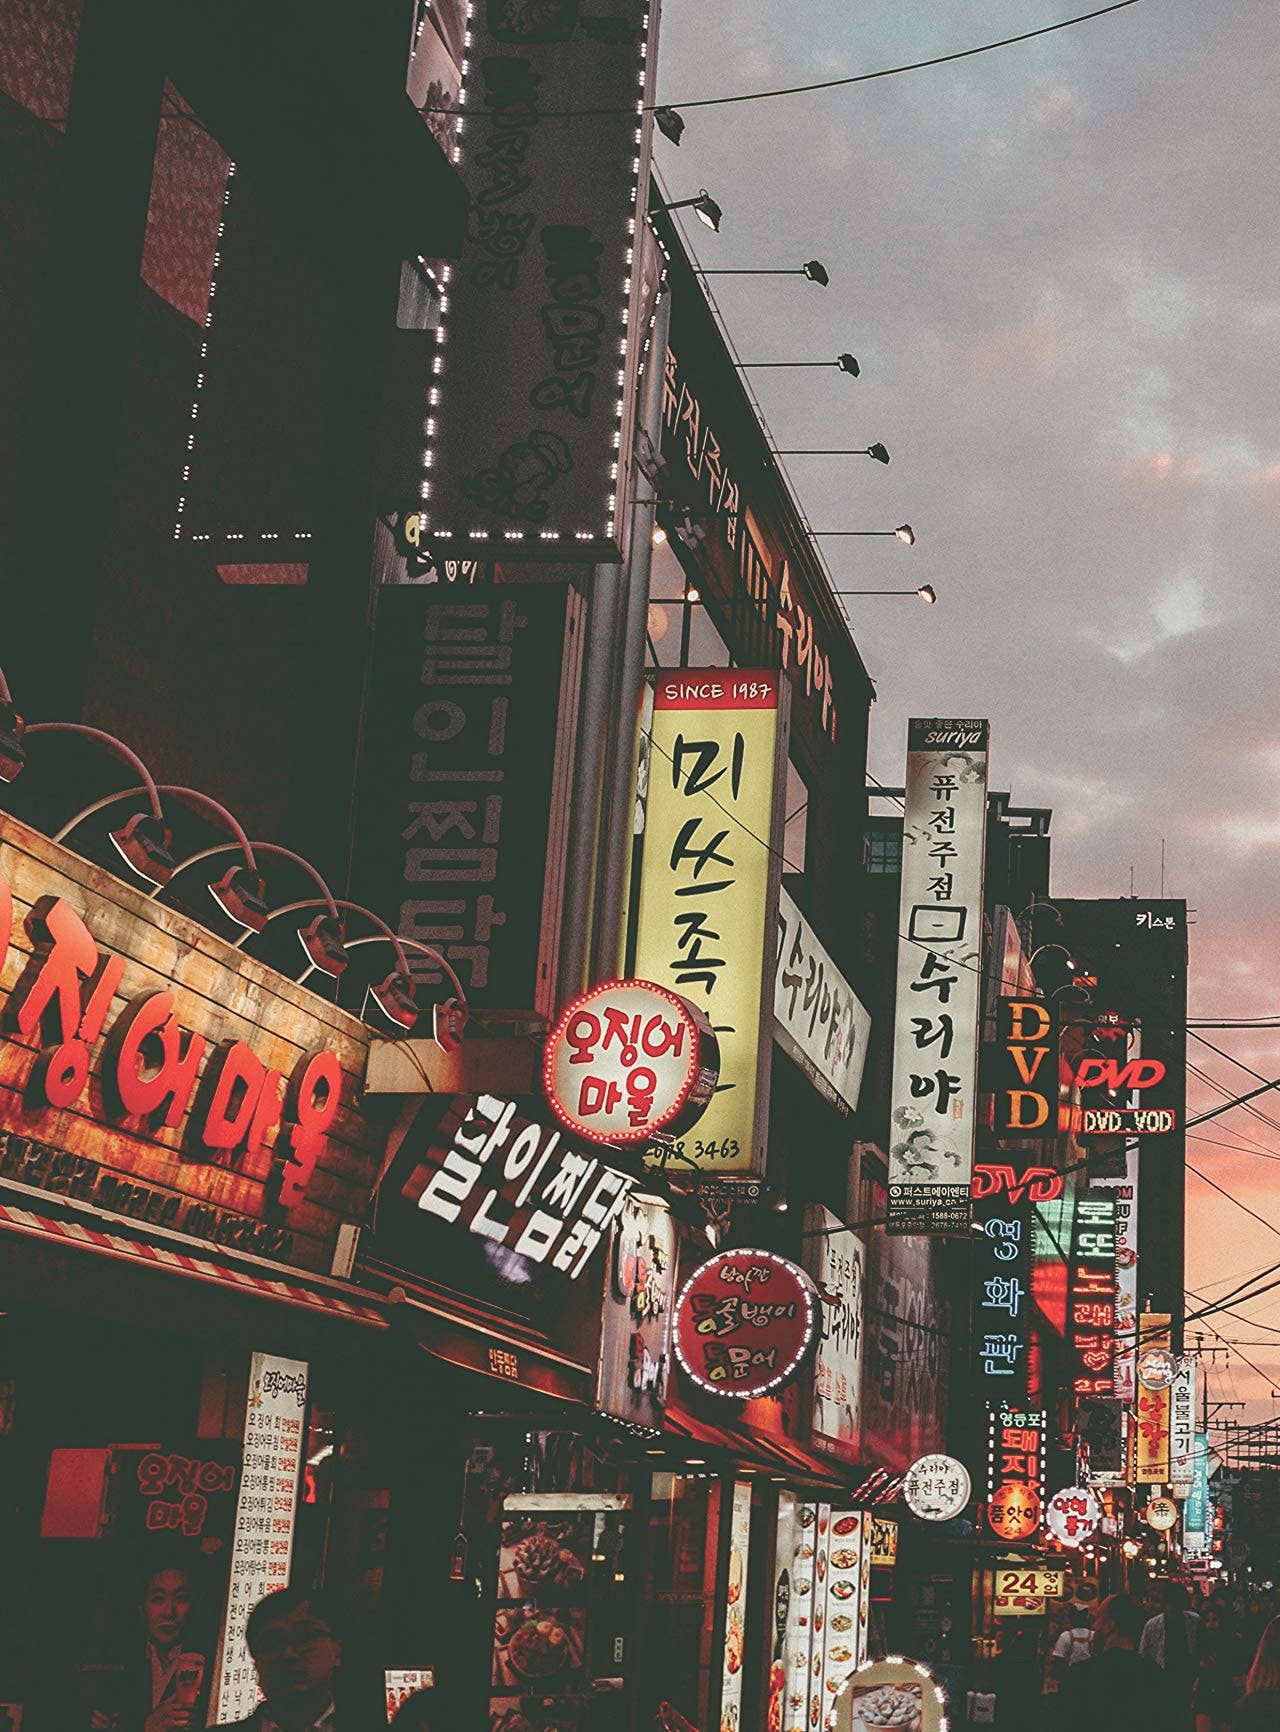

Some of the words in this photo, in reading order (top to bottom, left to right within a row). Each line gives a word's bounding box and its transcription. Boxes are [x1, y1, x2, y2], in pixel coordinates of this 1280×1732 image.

[665, 684, 724, 700] SINCE
[732, 683, 772, 701] 1987
[924, 729, 983, 749] suriya
[927, 774, 960, 902] 퓨전주점
[669, 731, 745, 1092] 미쓰족
[0, 884, 342, 1206] 징어마을
[565, 1006, 686, 1068] 오징어
[908, 952, 963, 1116] 수리야
[1006, 1001, 1051, 1130] DVD
[1074, 1058, 1167, 1090] DVD
[577, 1066, 658, 1127] 마을
[1084, 1111, 1122, 1133] DVD
[694, 1137, 740, 1160] 3463
[903, 1186, 969, 1198] 퍼스트에이엔티
[972, 1163, 1064, 1205] DVD
[931, 1211, 968, 1220] 1588-0672
[703, 1341, 777, 1382] 통문어
[1175, 1369, 1191, 1453] 서울불고기
[918, 1461, 951, 1475] 수리야
[908, 1478, 960, 1497] 퓨전주점
[1002, 1572, 1039, 1594] 24
